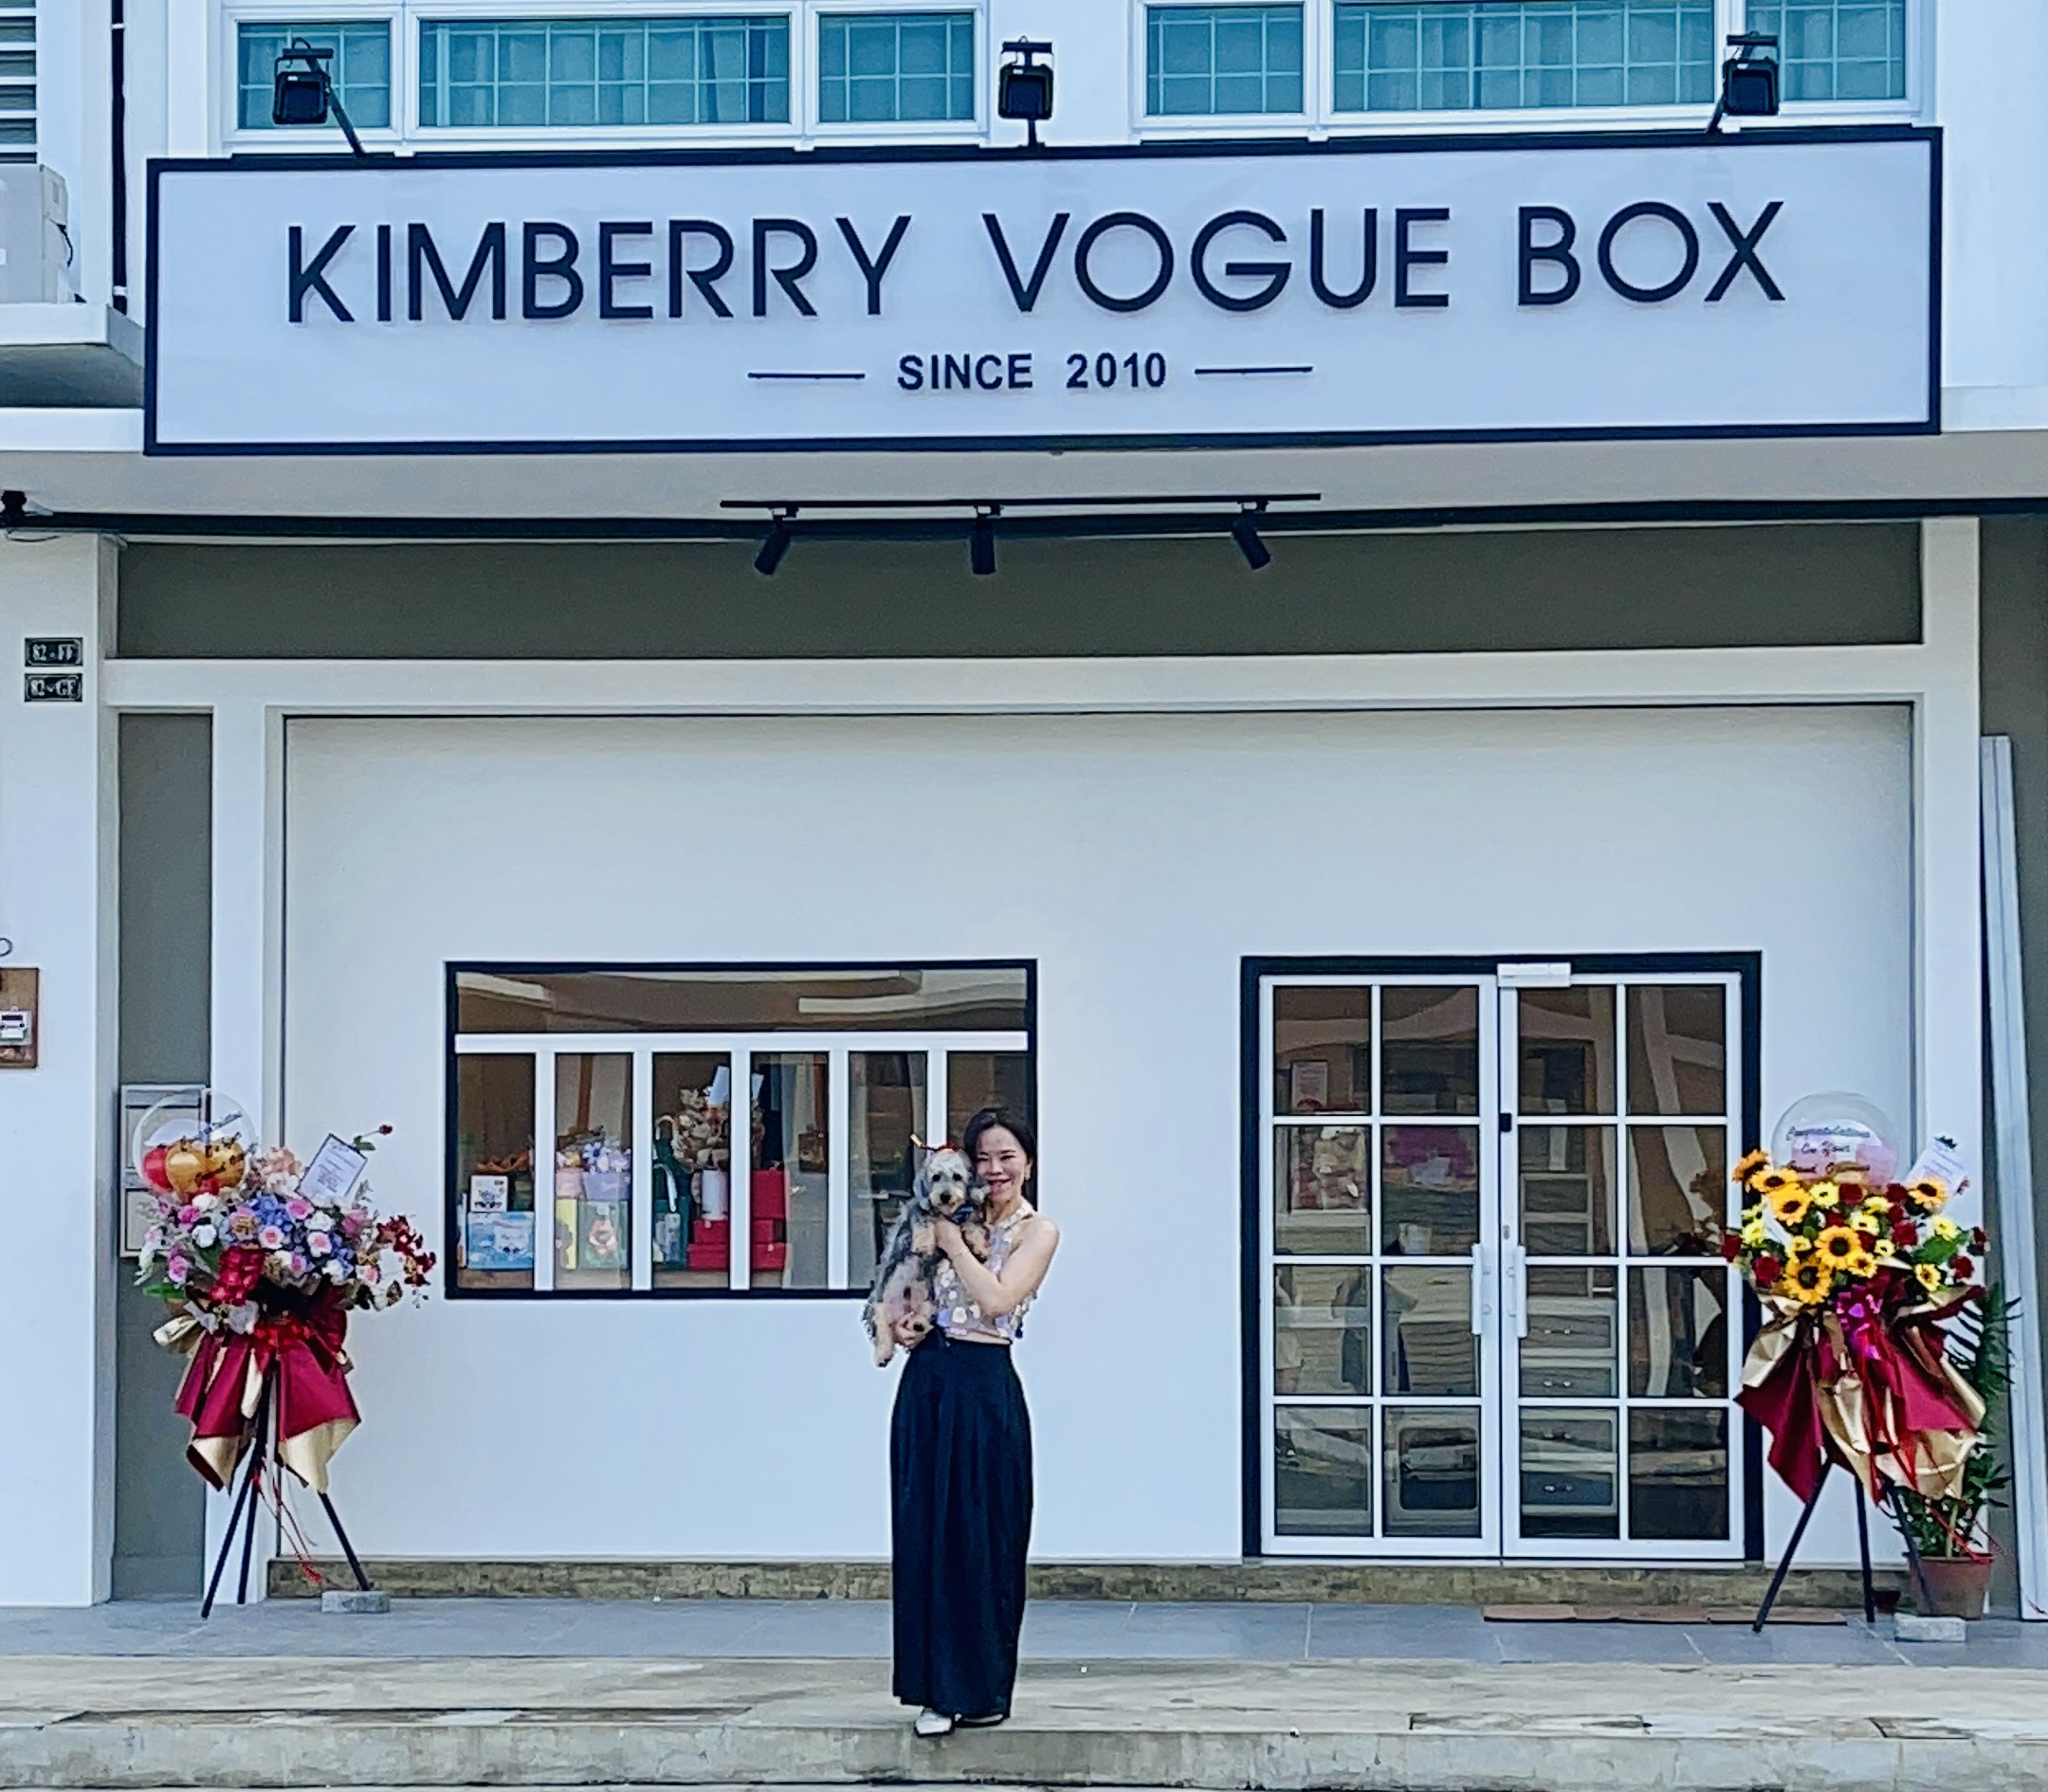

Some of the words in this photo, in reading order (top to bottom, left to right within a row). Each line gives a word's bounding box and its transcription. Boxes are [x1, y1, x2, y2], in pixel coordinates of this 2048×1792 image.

[289, 218, 911, 323] KIMBERRY
[982, 207, 1450, 314] VOGUE
[1518, 200, 1786, 307] BOX
[898, 354, 1033, 391] SINCE
[1067, 352, 1166, 390] 2010
